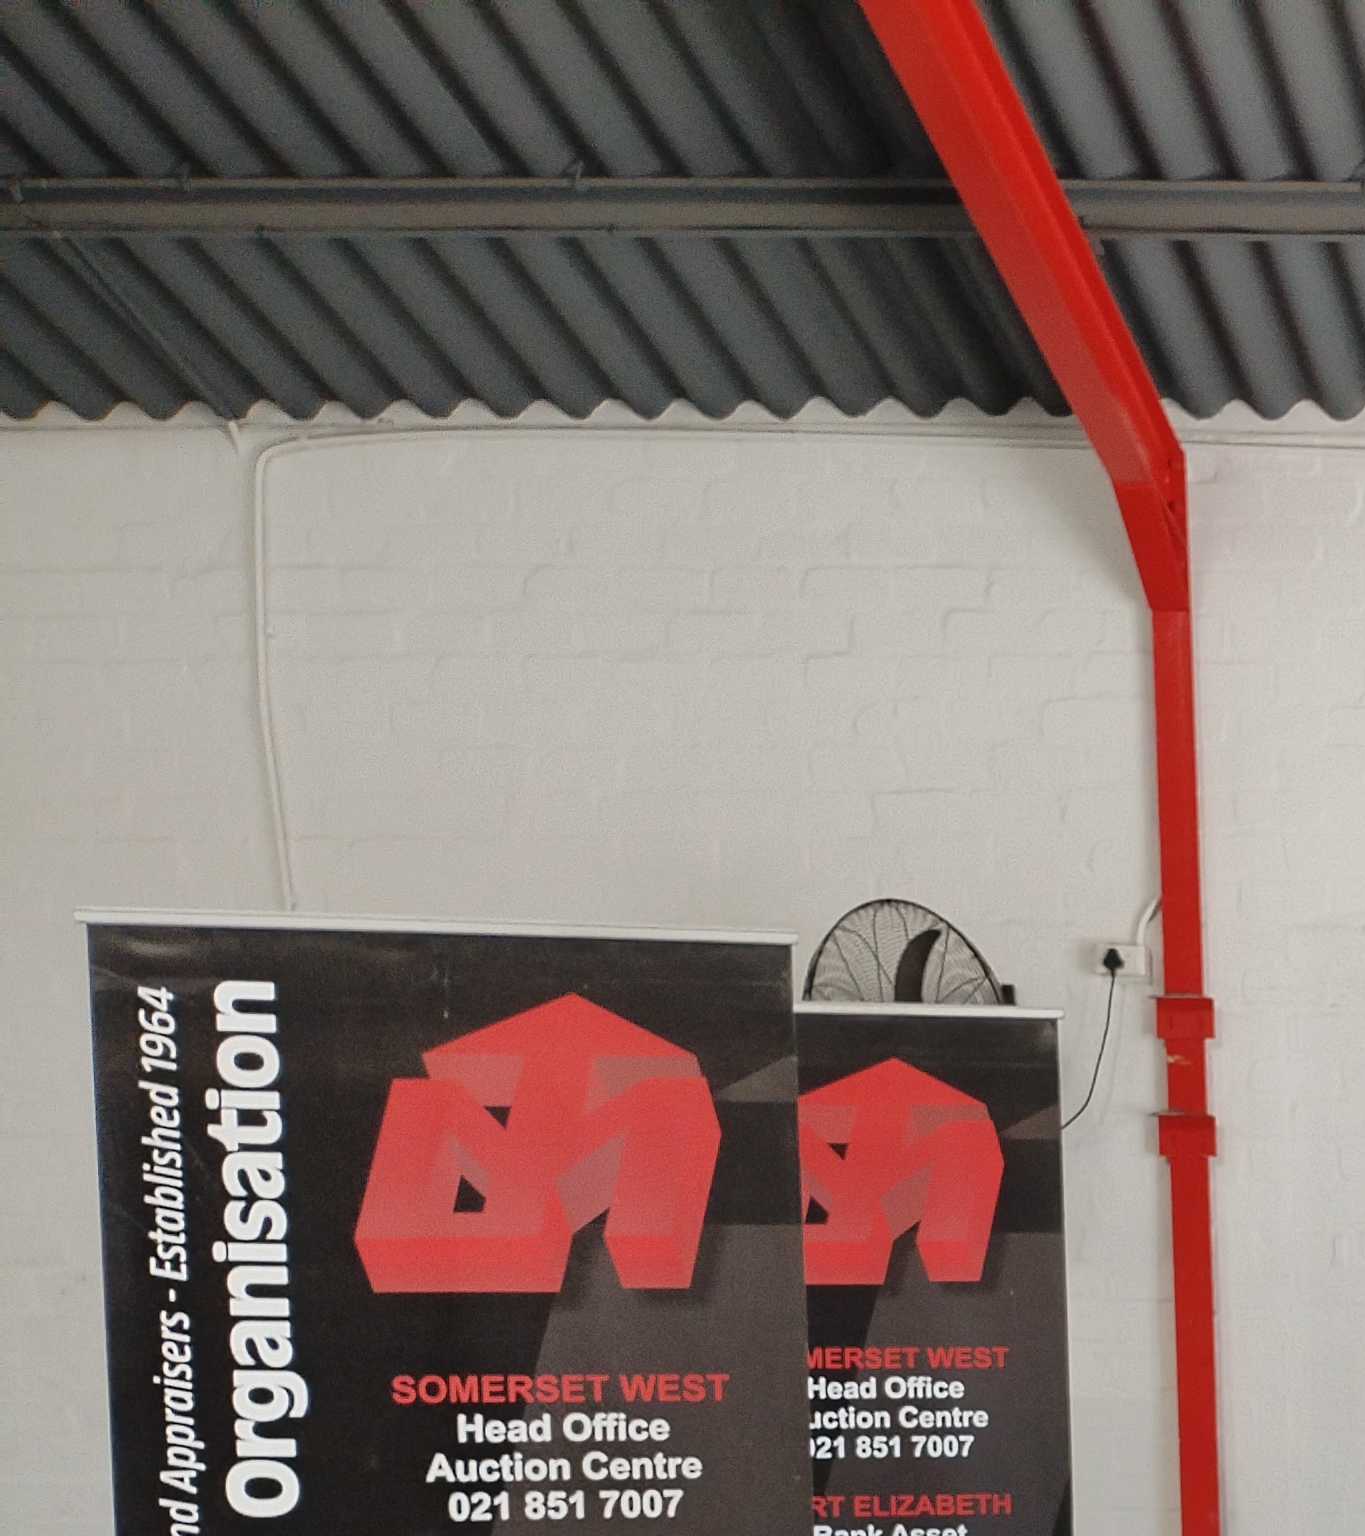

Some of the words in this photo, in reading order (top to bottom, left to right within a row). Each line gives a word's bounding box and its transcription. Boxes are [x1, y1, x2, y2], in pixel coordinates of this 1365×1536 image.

[138, 986, 177, 1072] 1964
[138, 1080, 187, 1281] Established
[205, 981, 308, 1517] Organisation
[807, 1347, 919, 1369] MERSET
[927, 1347, 1009, 1368] WEST
[153, 1310, 206, 1494] Appraisers
[393, 1374, 609, 1404] SOMERSET
[619, 1374, 729, 1401] WEST
[808, 1377, 876, 1399] Head
[885, 1376, 964, 1398] Office
[458, 1413, 551, 1443] Head
[563, 1412, 670, 1441] Office
[809, 1406, 890, 1429] uction
[899, 1406, 988, 1428] Centre
[856, 1436, 900, 1458] 851
[911, 1435, 974, 1457] 7007
[426, 1452, 570, 1482] Auction
[582, 1451, 702, 1480] Centre
[449, 1492, 509, 1521] 021
[525, 1490, 584, 1520] 851
[599, 1490, 683, 1518] 7007
[811, 1496, 845, 1517] RT
[854, 1494, 1011, 1517] ELIZABETH
